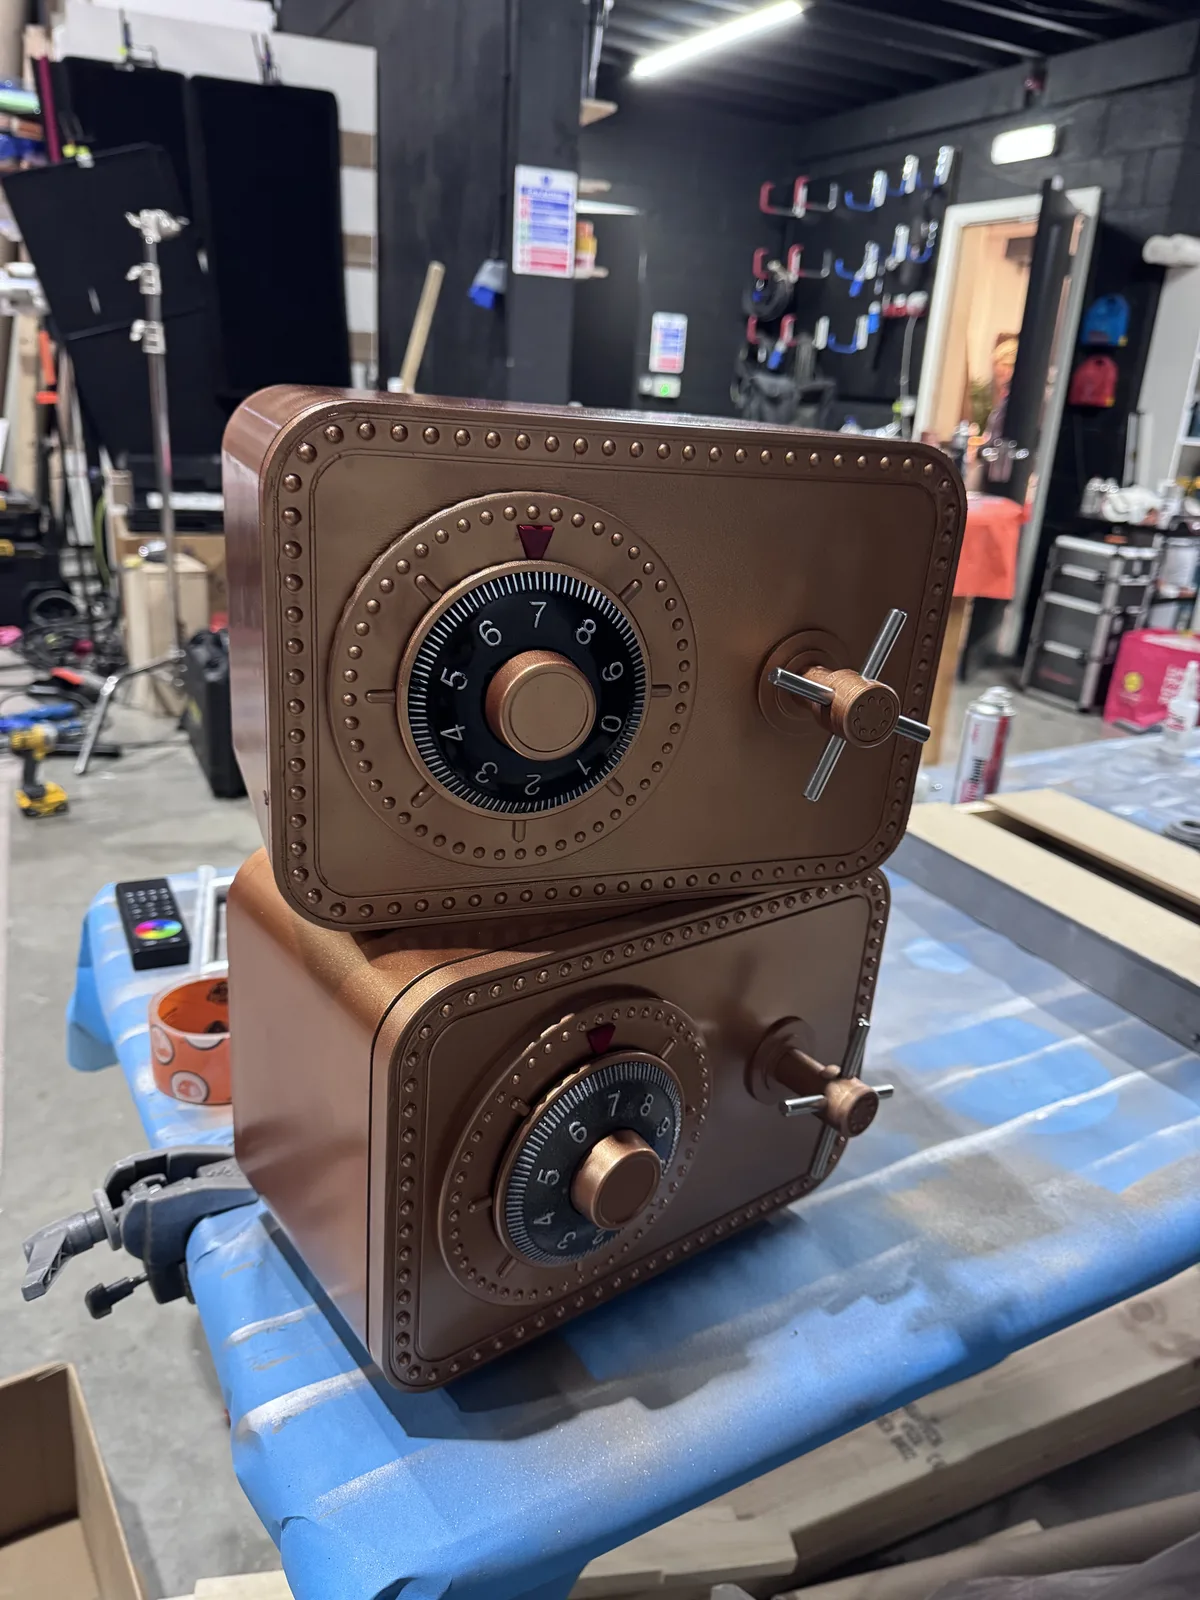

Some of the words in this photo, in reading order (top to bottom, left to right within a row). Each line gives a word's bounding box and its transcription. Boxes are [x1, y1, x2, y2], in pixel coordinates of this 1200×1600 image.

[529, 601, 547, 628] 7
[478, 620, 502, 647] 6
[575, 618, 597, 645] 8
[440, 667, 468, 690] 5
[602, 661, 624, 682] 9
[439, 724, 466, 741] 4
[601, 715, 622, 733] 0
[474, 761, 499, 784] 3
[576, 759, 592, 776] 1
[524, 774, 542, 796] 2
[608, 1090, 621, 1117] 7
[639, 1093, 654, 1117] 8
[568, 1121, 588, 1144] 6
[656, 1116, 671, 1138] 9
[536, 1168, 560, 1186] 5
[533, 1211, 555, 1226] 4
[557, 1231, 577, 1250] 3
